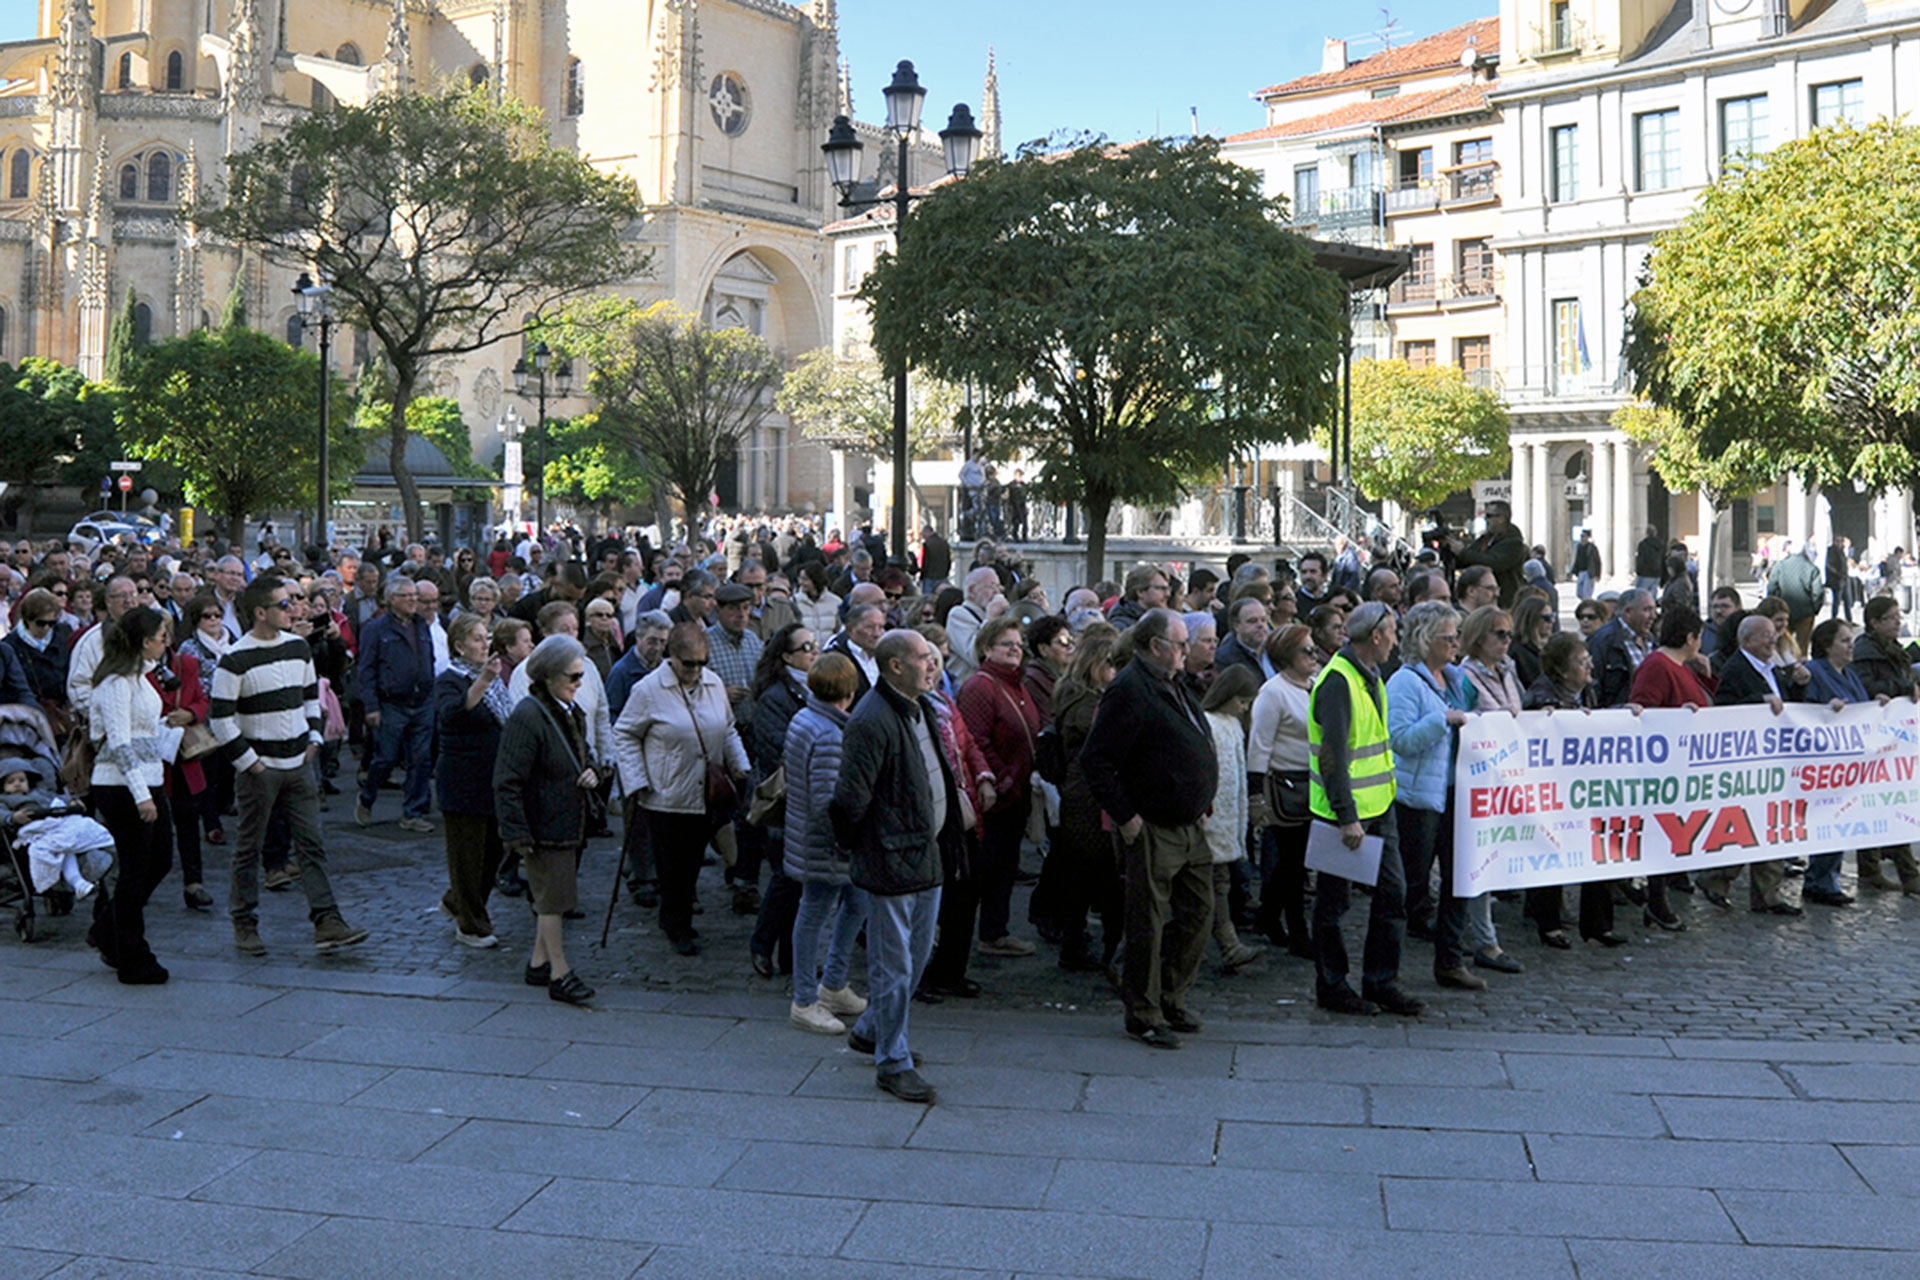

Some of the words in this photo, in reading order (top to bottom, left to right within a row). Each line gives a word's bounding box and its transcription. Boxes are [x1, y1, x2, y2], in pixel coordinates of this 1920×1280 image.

[1527, 738, 1554, 768] EL
[1562, 734, 1669, 766] BARRIO
[1470, 783, 1536, 818] EXIGE
[1539, 782, 1563, 811] EL
[1570, 776, 1679, 809] CENTRO
[1685, 774, 1714, 802] DE
[1718, 766, 1785, 799] SALUD
